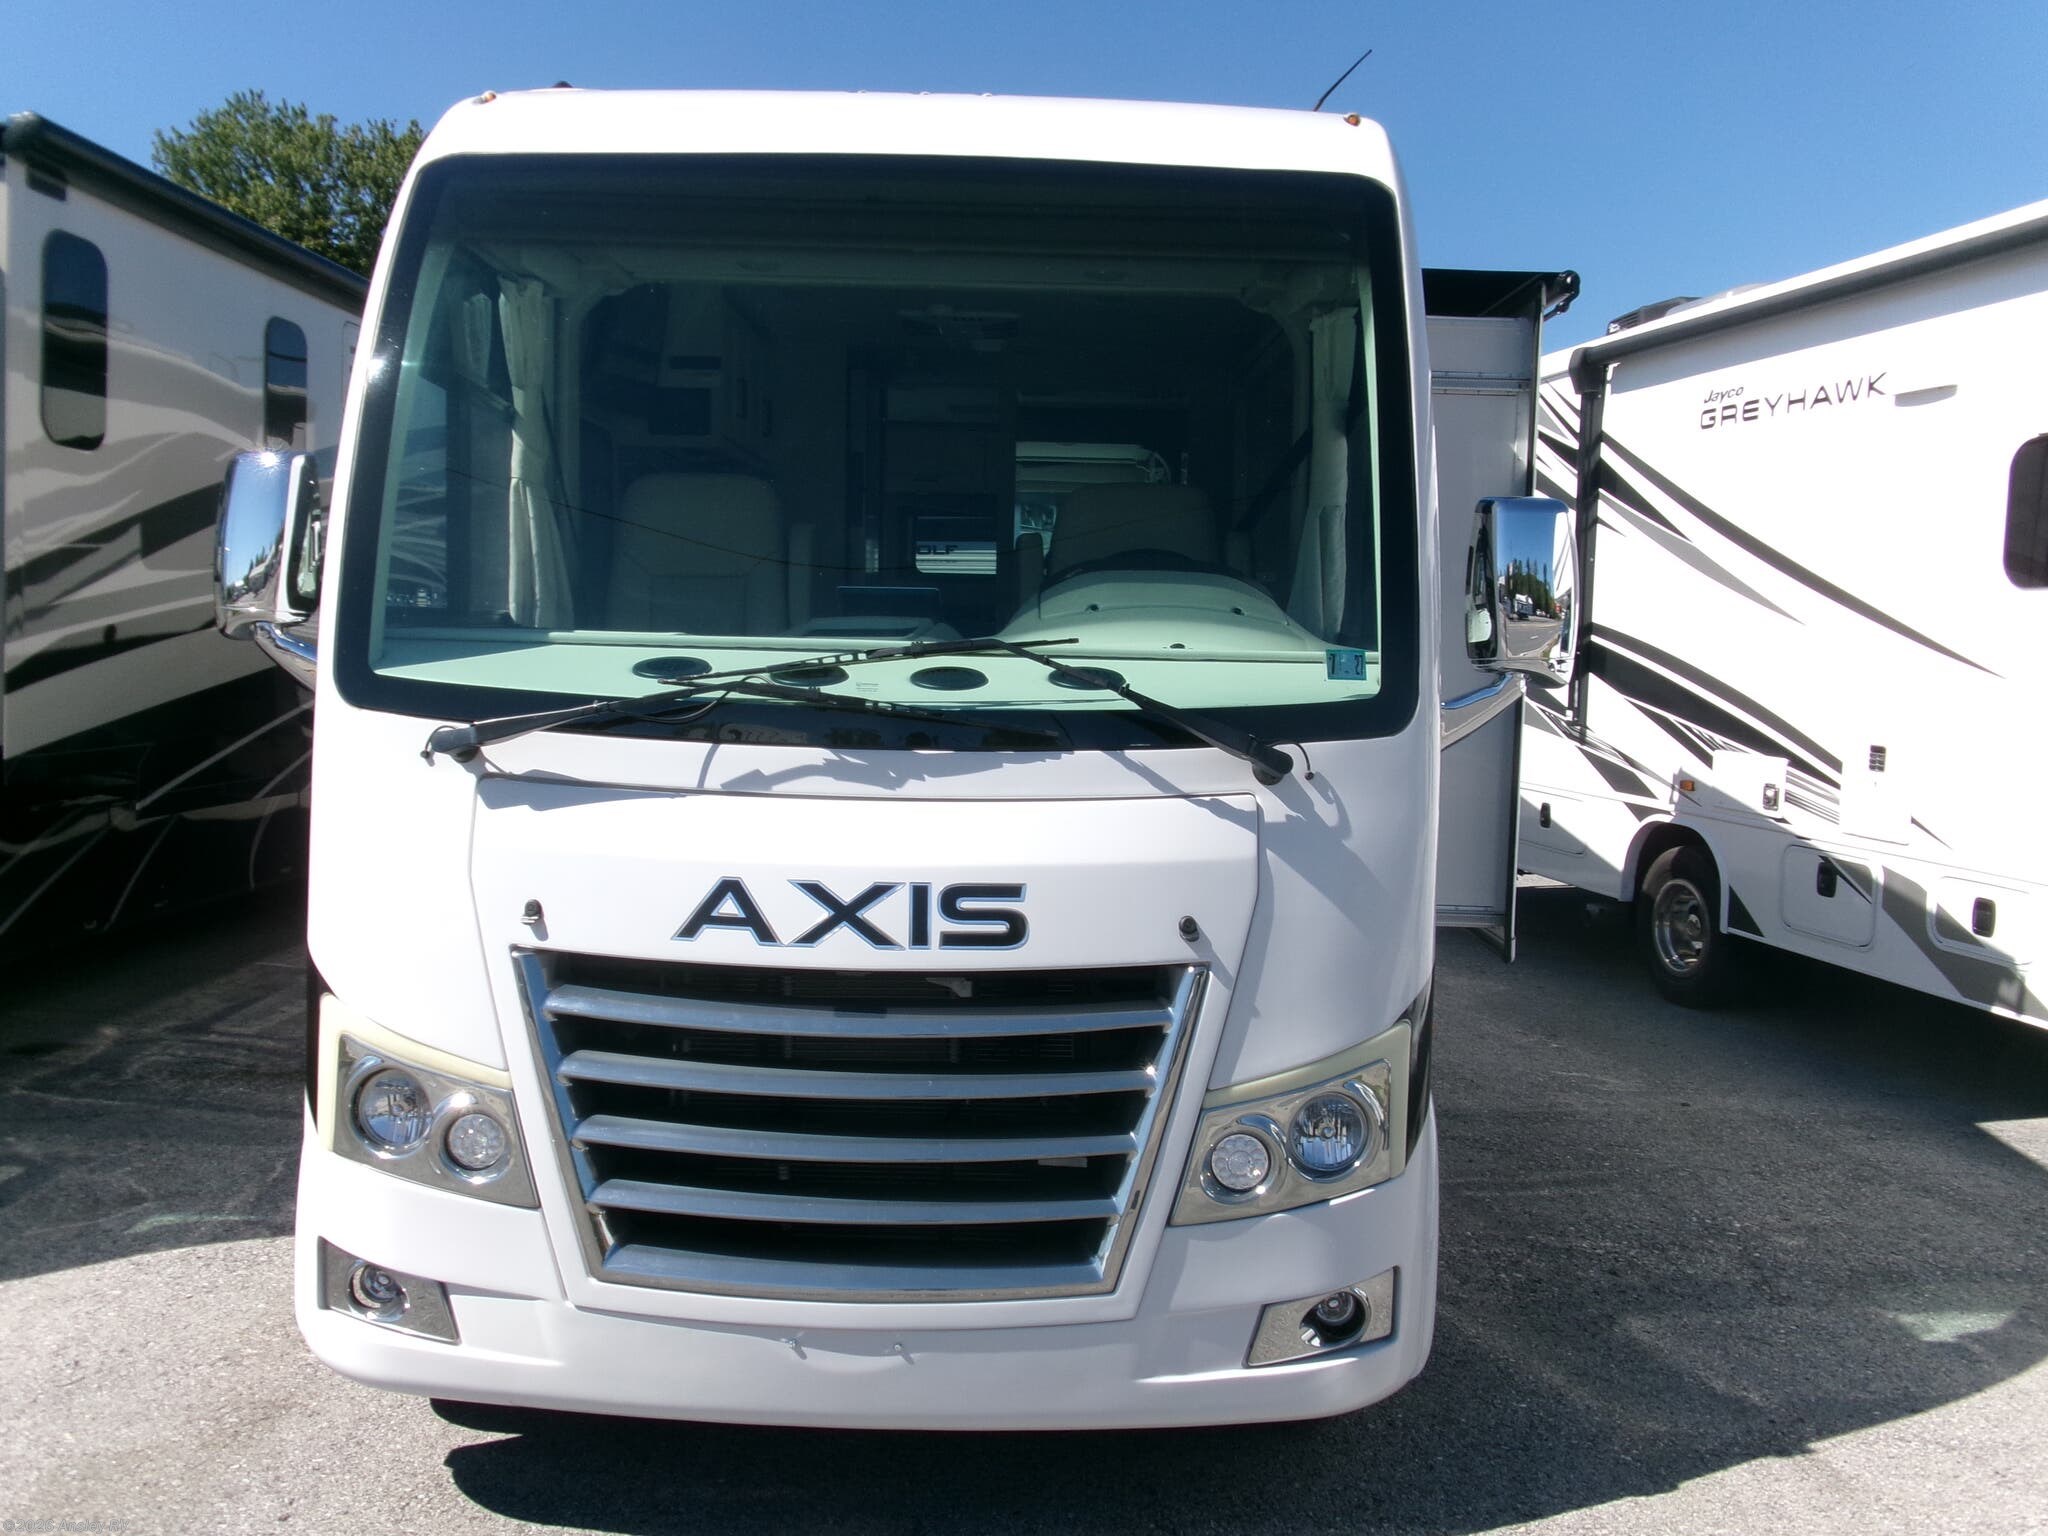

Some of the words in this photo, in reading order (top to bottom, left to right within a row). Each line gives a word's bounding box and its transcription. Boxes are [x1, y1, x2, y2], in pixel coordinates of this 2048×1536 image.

[1700, 372, 1887, 430] GREYHAWK
[1703, 386, 1744, 404] Jayco
[670, 875, 1030, 951] AXIS
